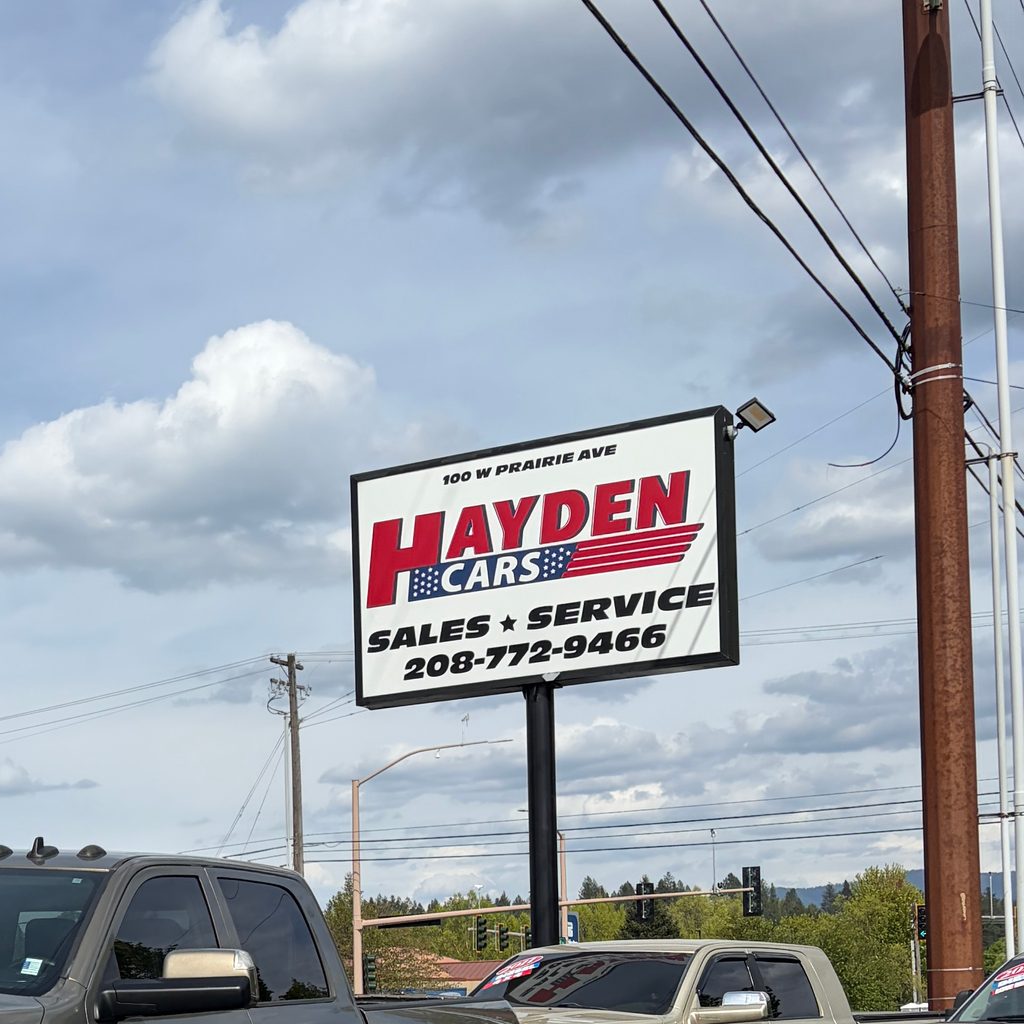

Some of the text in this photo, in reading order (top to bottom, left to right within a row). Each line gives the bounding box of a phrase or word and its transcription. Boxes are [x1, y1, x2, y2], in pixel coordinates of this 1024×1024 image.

[443, 444, 617, 485] 100 W PRAIRIE AVE
[366, 470, 690, 609] HAYDEN
[441, 552, 541, 592] CARS
[367, 582, 715, 653] SALES SERVICE
[403, 624, 667, 680] 208-772-9466
